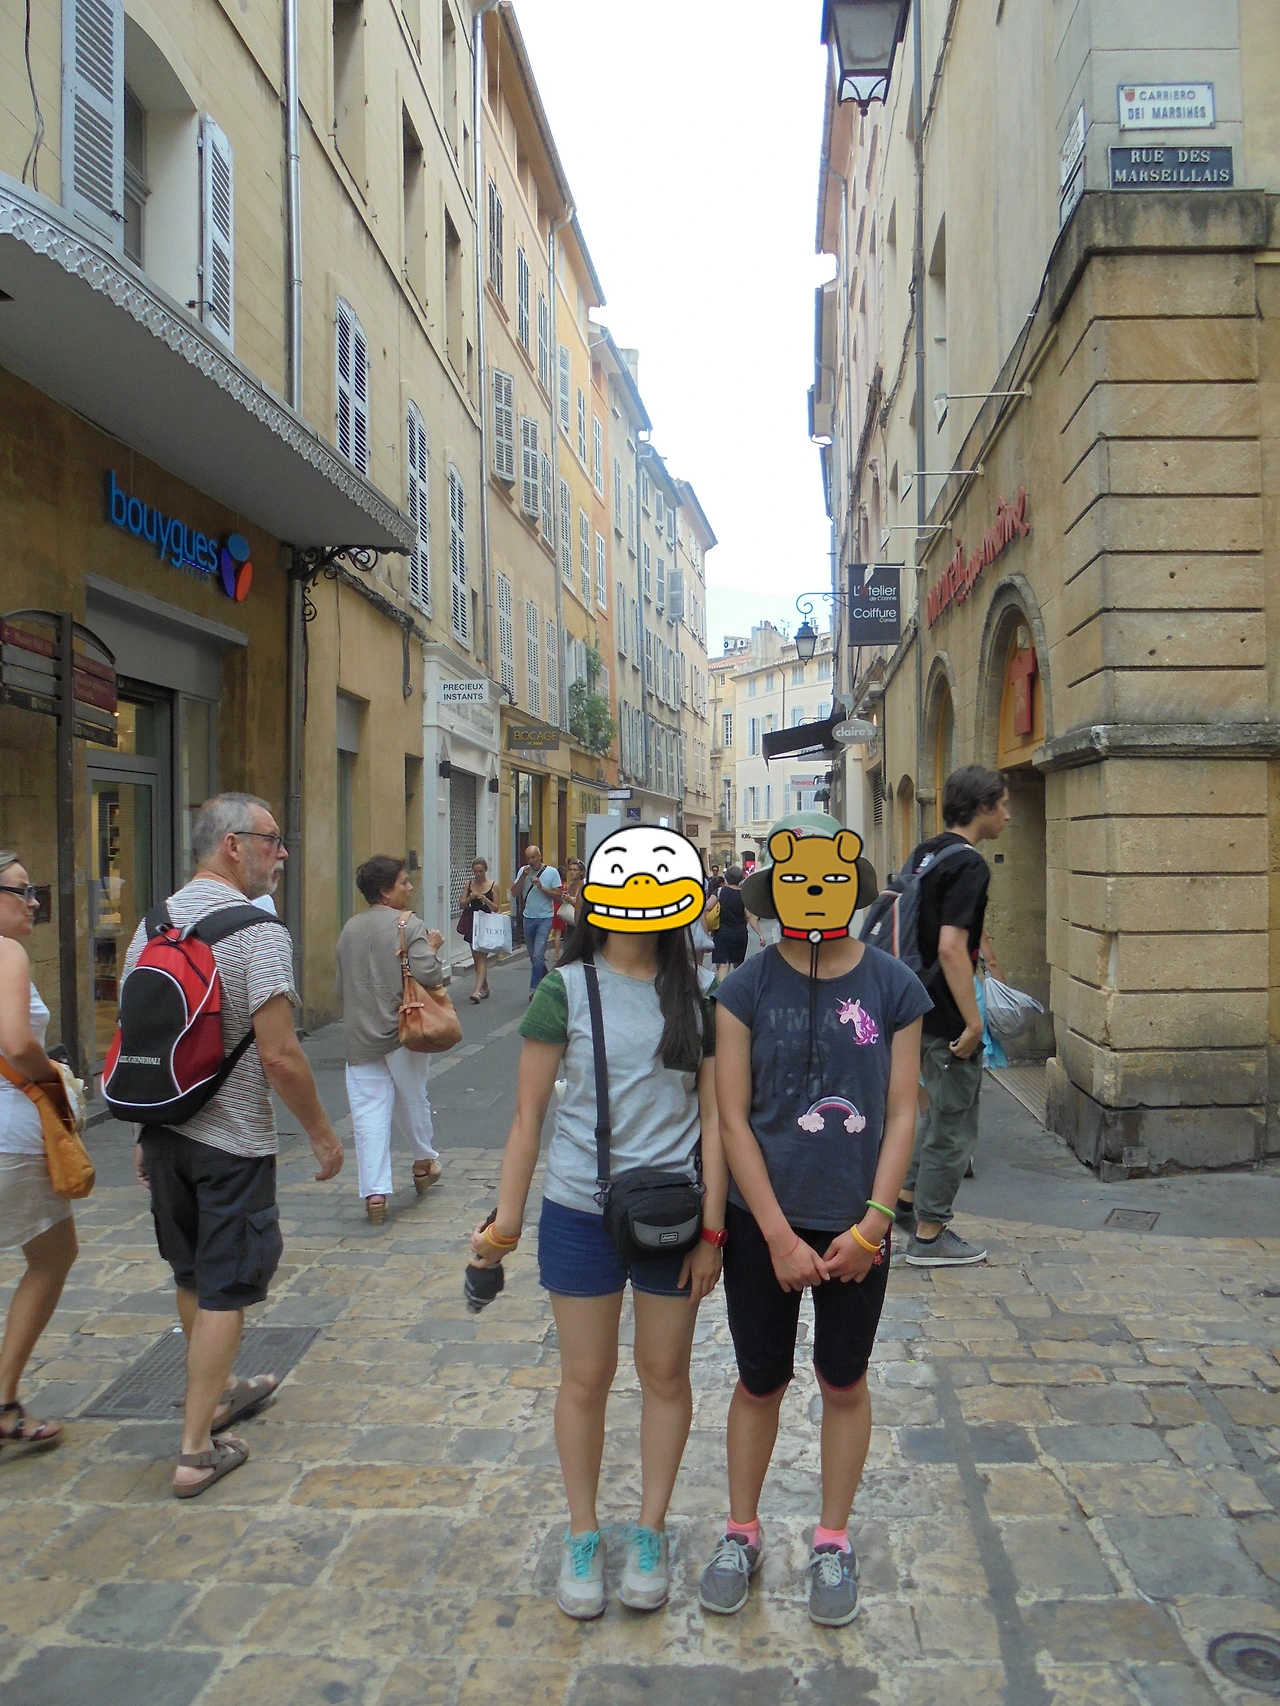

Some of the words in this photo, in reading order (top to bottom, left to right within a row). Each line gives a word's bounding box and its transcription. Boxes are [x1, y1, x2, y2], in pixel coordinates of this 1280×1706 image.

[1139, 90, 1195, 101] CARRIERO
[1128, 107, 1144, 120] DEI
[1131, 149, 1165, 163] RUE
[1178, 149, 1211, 163] DES
[1114, 169, 1230, 183] MARSEILLAIS
[111, 469, 218, 572] bouygues
[853, 608, 897, 619] Coiffure
[443, 683, 484, 691] PRECIEUX
[443, 692, 484, 701] INSTANTS
[514, 730, 557, 741] BOCAGE
[836, 725, 873, 737] claire's
[128, 1055, 161, 1065] GENERALI
